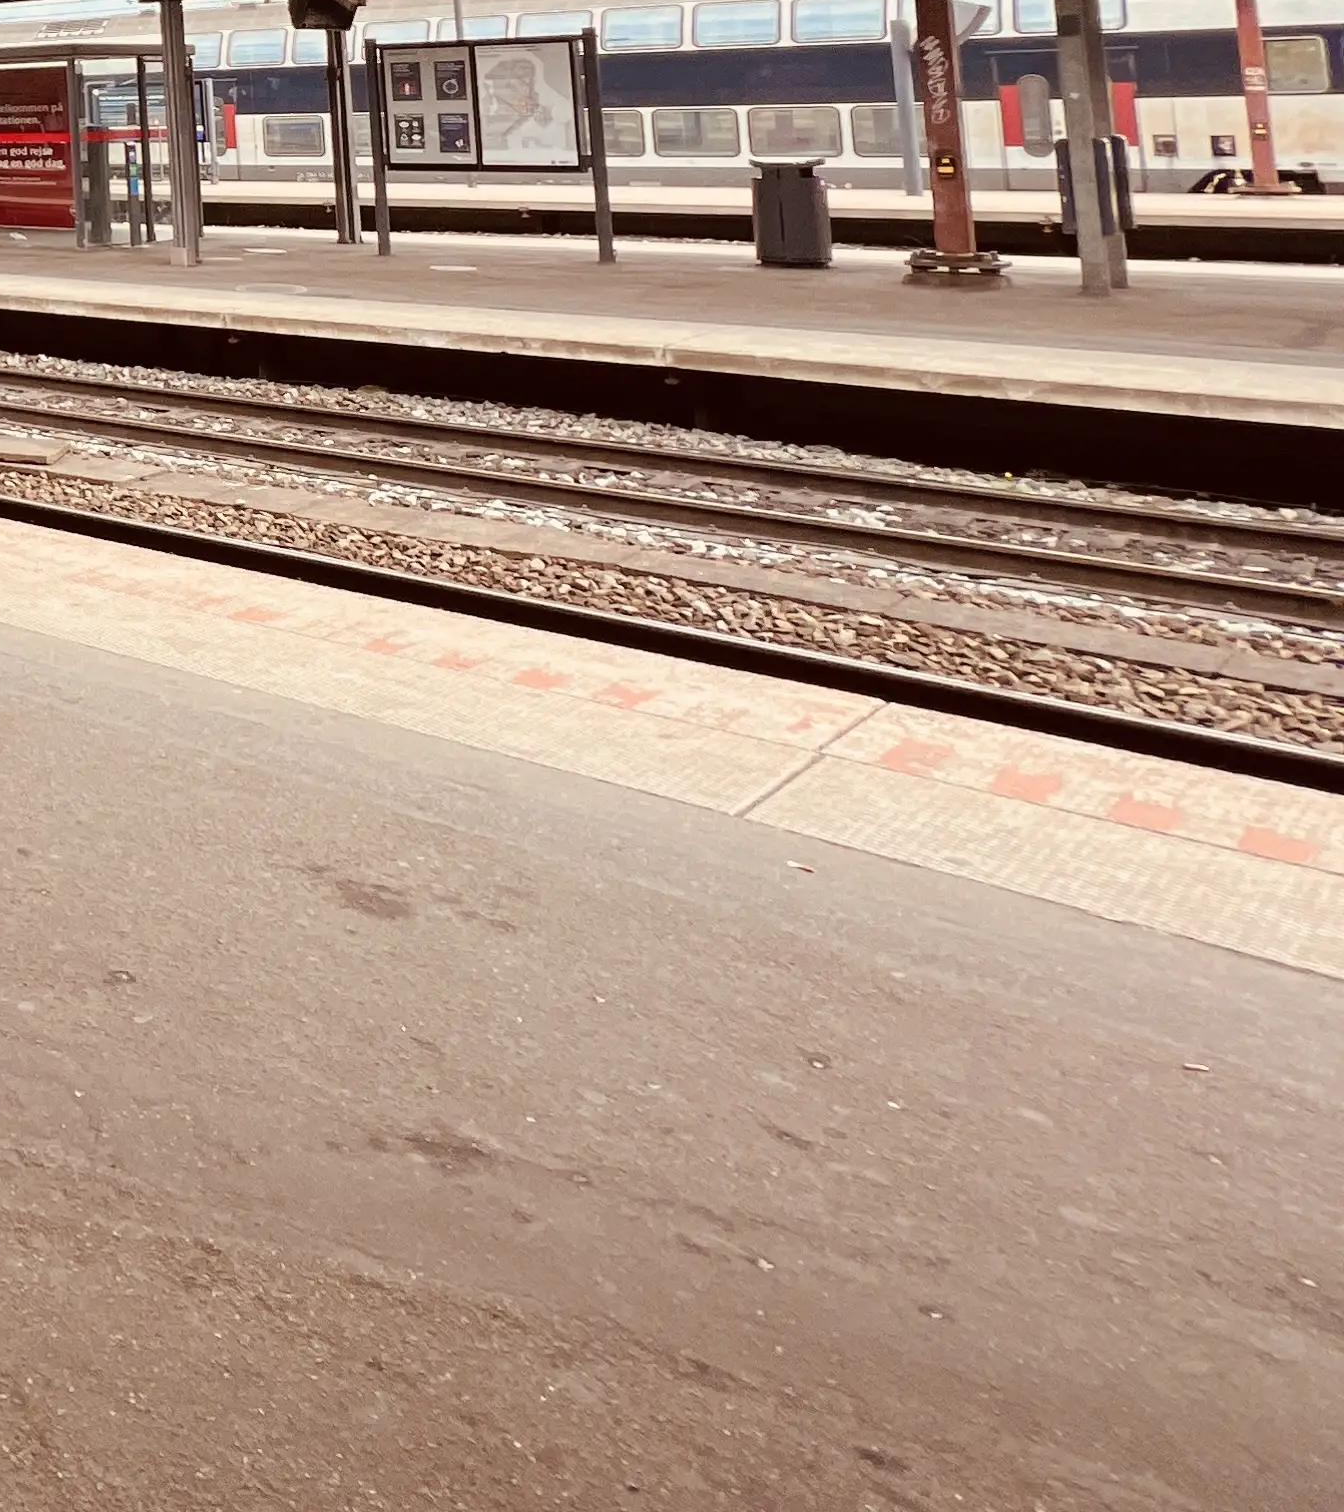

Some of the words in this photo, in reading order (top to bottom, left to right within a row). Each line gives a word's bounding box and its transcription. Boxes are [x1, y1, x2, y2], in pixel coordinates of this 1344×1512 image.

[50, 101, 64, 116] på
[9, 146, 28, 157] god
[24, 157, 43, 170] god
